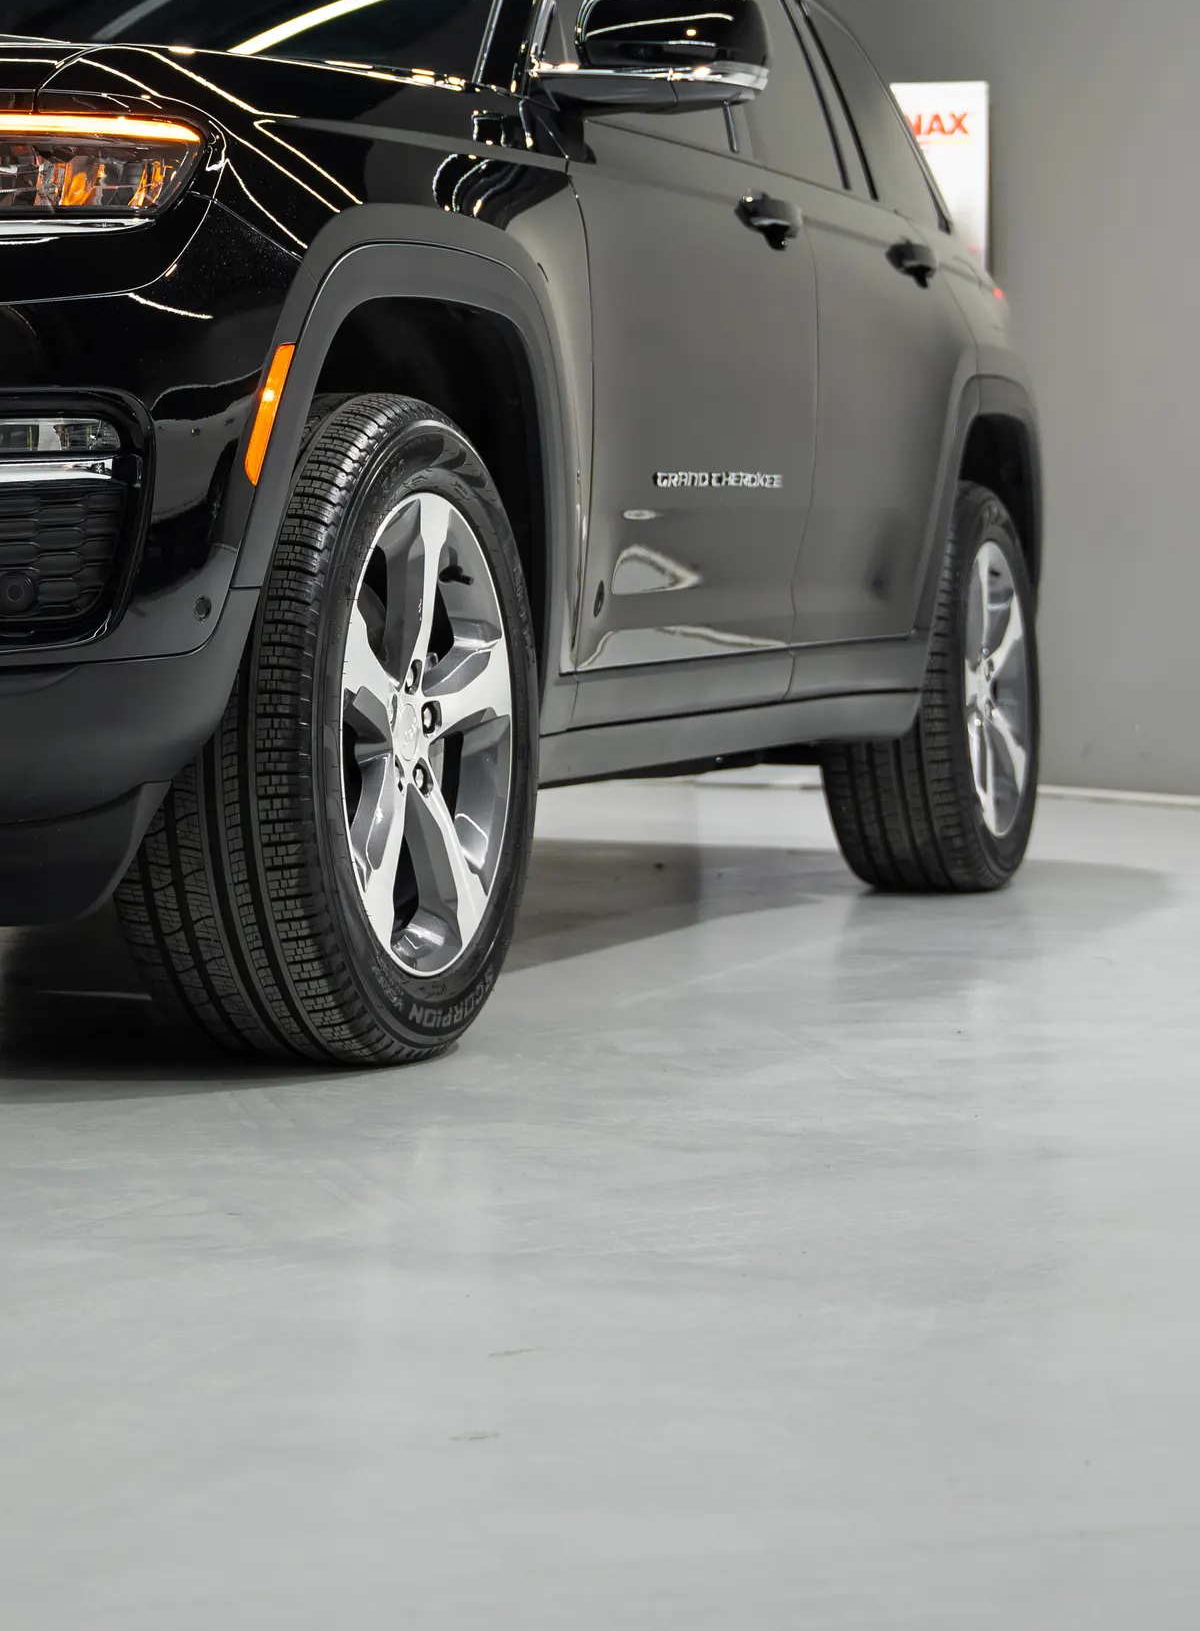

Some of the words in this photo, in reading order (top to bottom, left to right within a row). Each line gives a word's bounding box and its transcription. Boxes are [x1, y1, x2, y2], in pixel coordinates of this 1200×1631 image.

[655, 471, 709, 488] GRAND
[711, 471, 783, 489] CHEROKEE
[408, 965, 494, 1029] SCORPION
